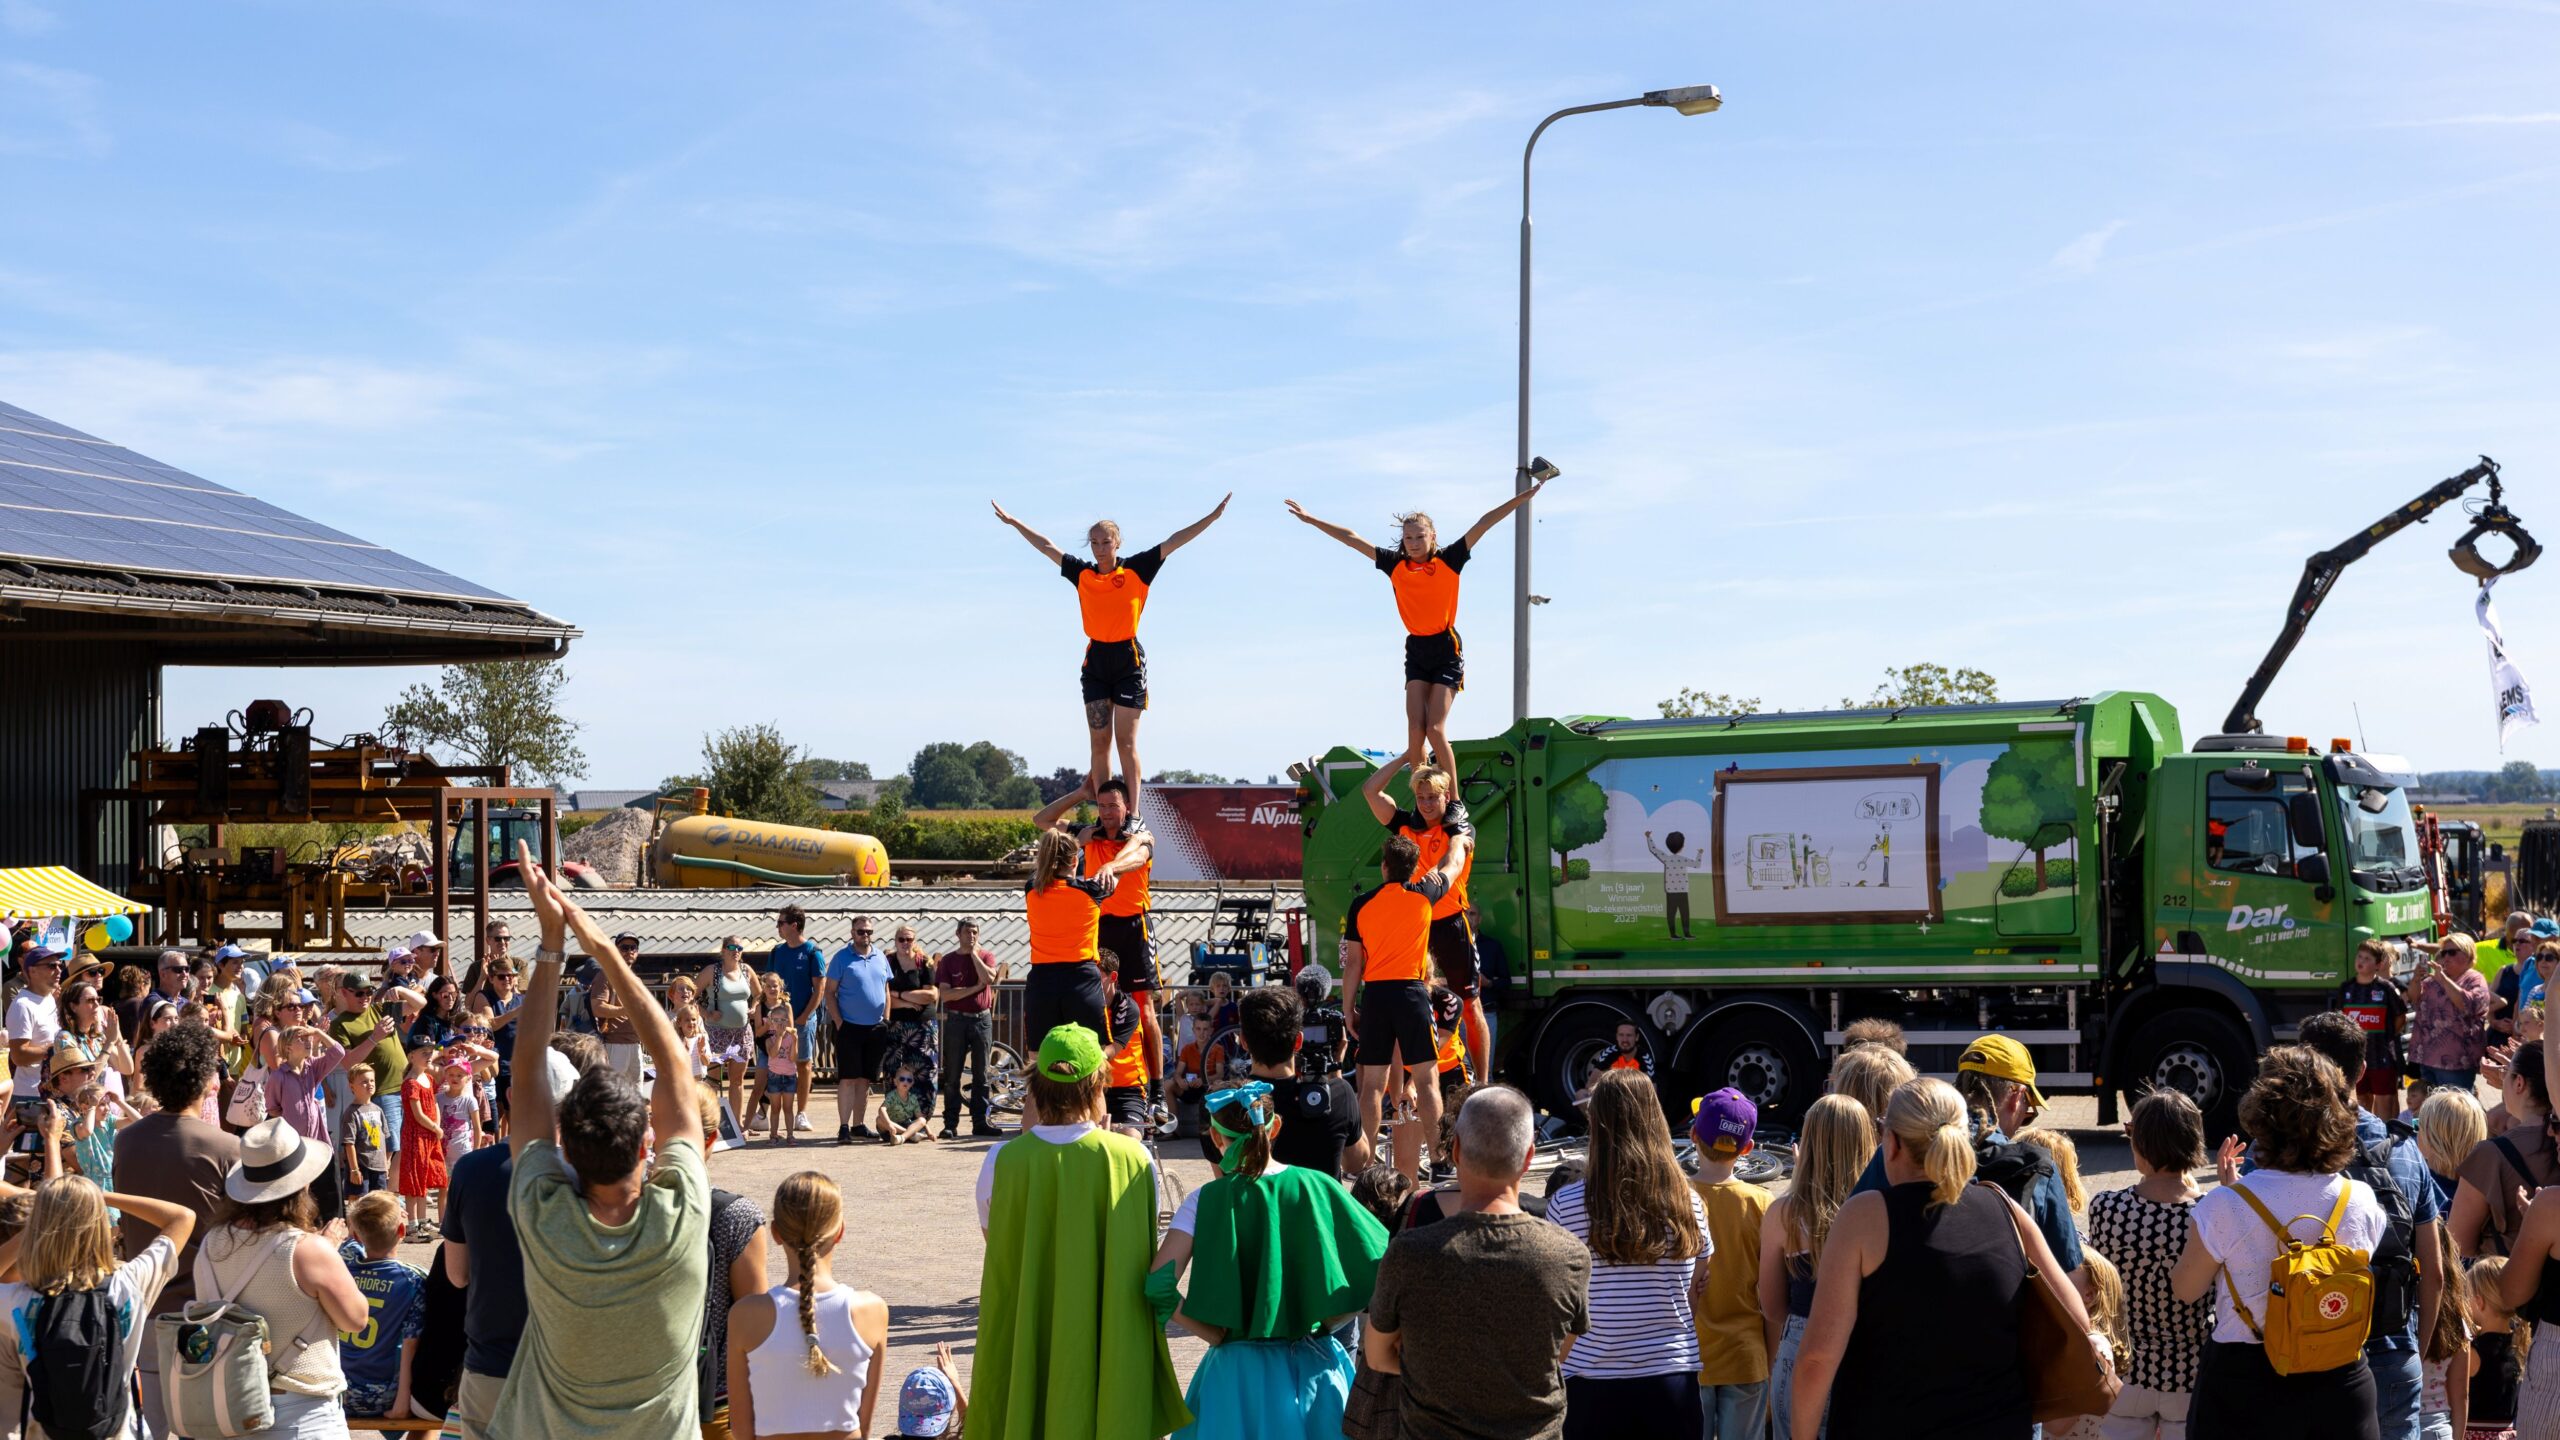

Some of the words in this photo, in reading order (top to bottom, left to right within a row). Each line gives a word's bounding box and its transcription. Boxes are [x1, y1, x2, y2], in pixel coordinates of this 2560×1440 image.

[734, 830, 825, 855] DAAMEN
[1615, 883, 1624, 893] (9
[1626, 883, 1644, 893] jaar)
[2208, 879, 2232, 887] 340
[1608, 894, 1641, 902] Winnaar
[2162, 894, 2187, 907] 212
[1587, 904, 1664, 914] Dar-tekenwedstrijd
[1614, 914, 1638, 923] 2023!
[2295, 926, 2310, 939] fris!
[2310, 971, 2338, 980] CF
[2359, 1014, 2380, 1024] DFDS
[1722, 1121, 1743, 1134] OBEY
[354, 1276, 395, 1293] GHORST
[339, 1297, 385, 1349] 5
